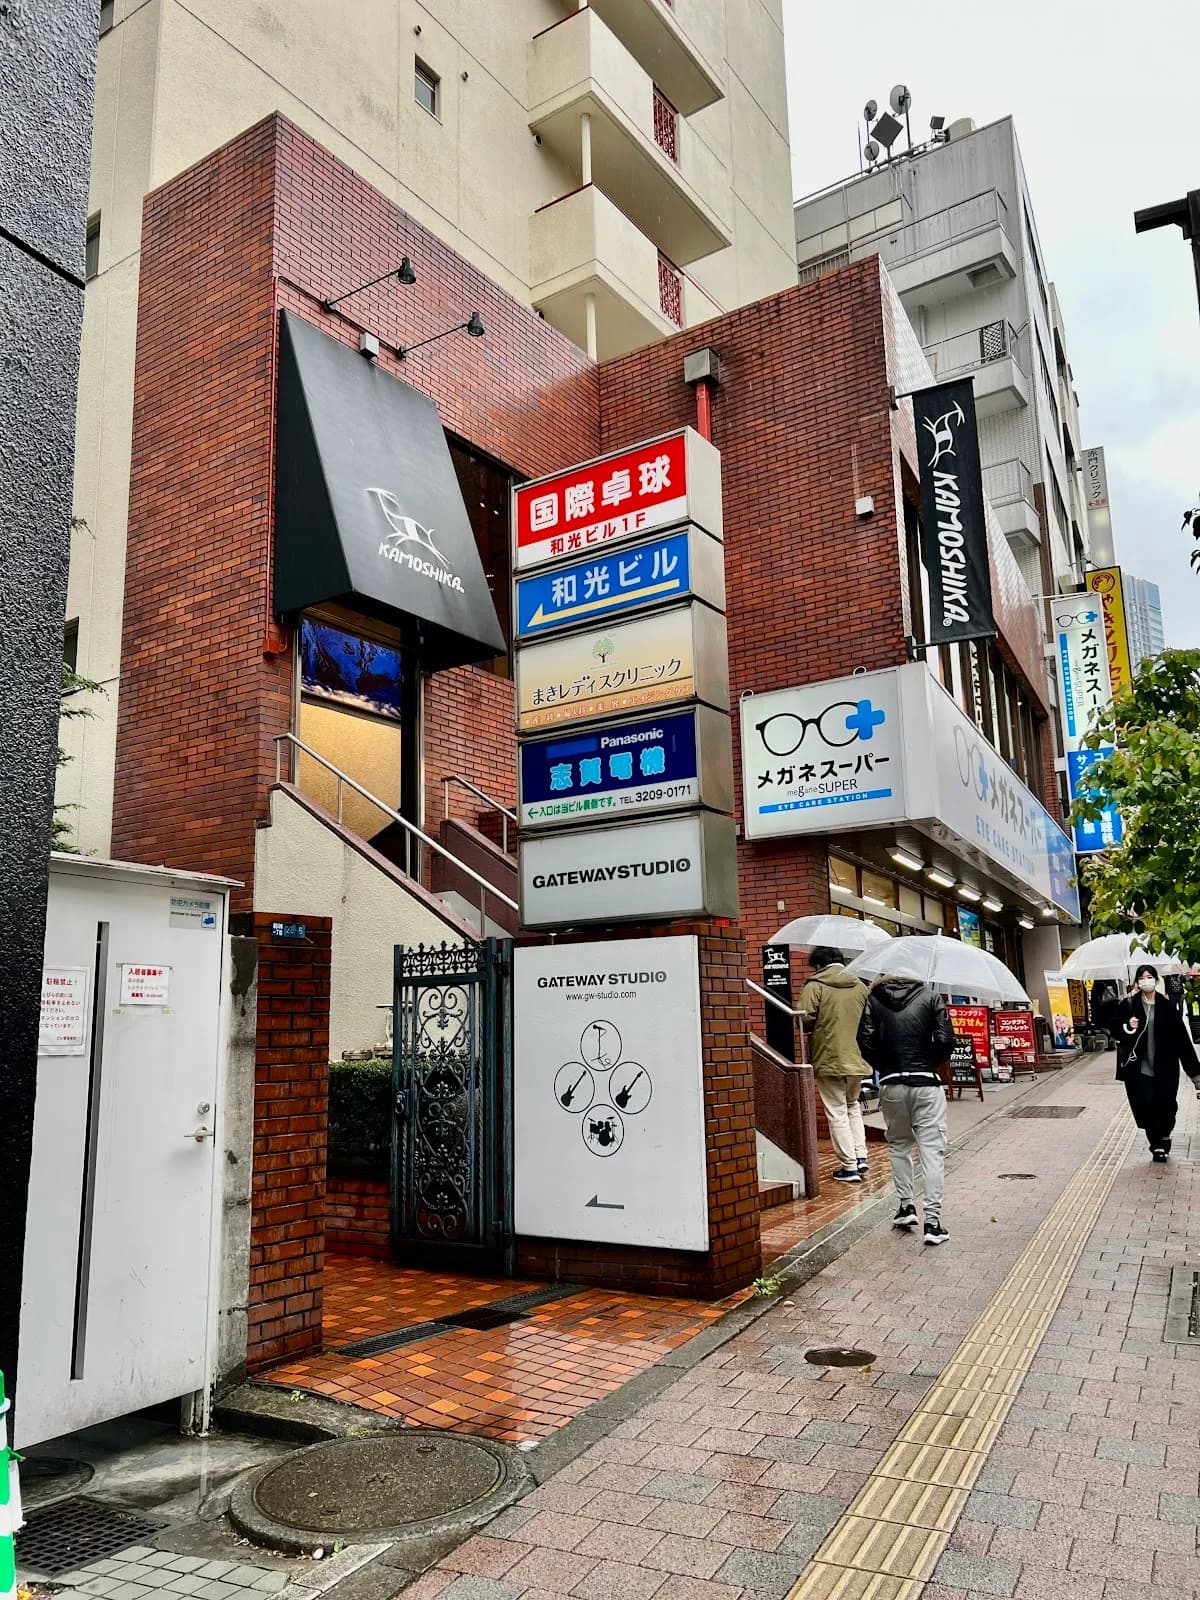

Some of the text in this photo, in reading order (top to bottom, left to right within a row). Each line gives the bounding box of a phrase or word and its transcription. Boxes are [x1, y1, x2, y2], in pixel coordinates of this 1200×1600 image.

[530, 454, 671, 532] 国際卓球
[932, 470, 970, 625] KAMOSHIKA
[379, 542, 464, 593] KAMOSHIKA
[552, 548, 678, 607] 和光ビル
[532, 658, 681, 705] まきレディスクリニック
[600, 727, 664, 749] Panasonic
[758, 752, 890, 789] メガネスーパー
[787, 779, 858, 797] meganeSUPER
[620, 796, 634, 805] TEL
[778, 792, 869, 812] EYE CARE STATION
[566, 990, 637, 1001] www.gw-studio.com
